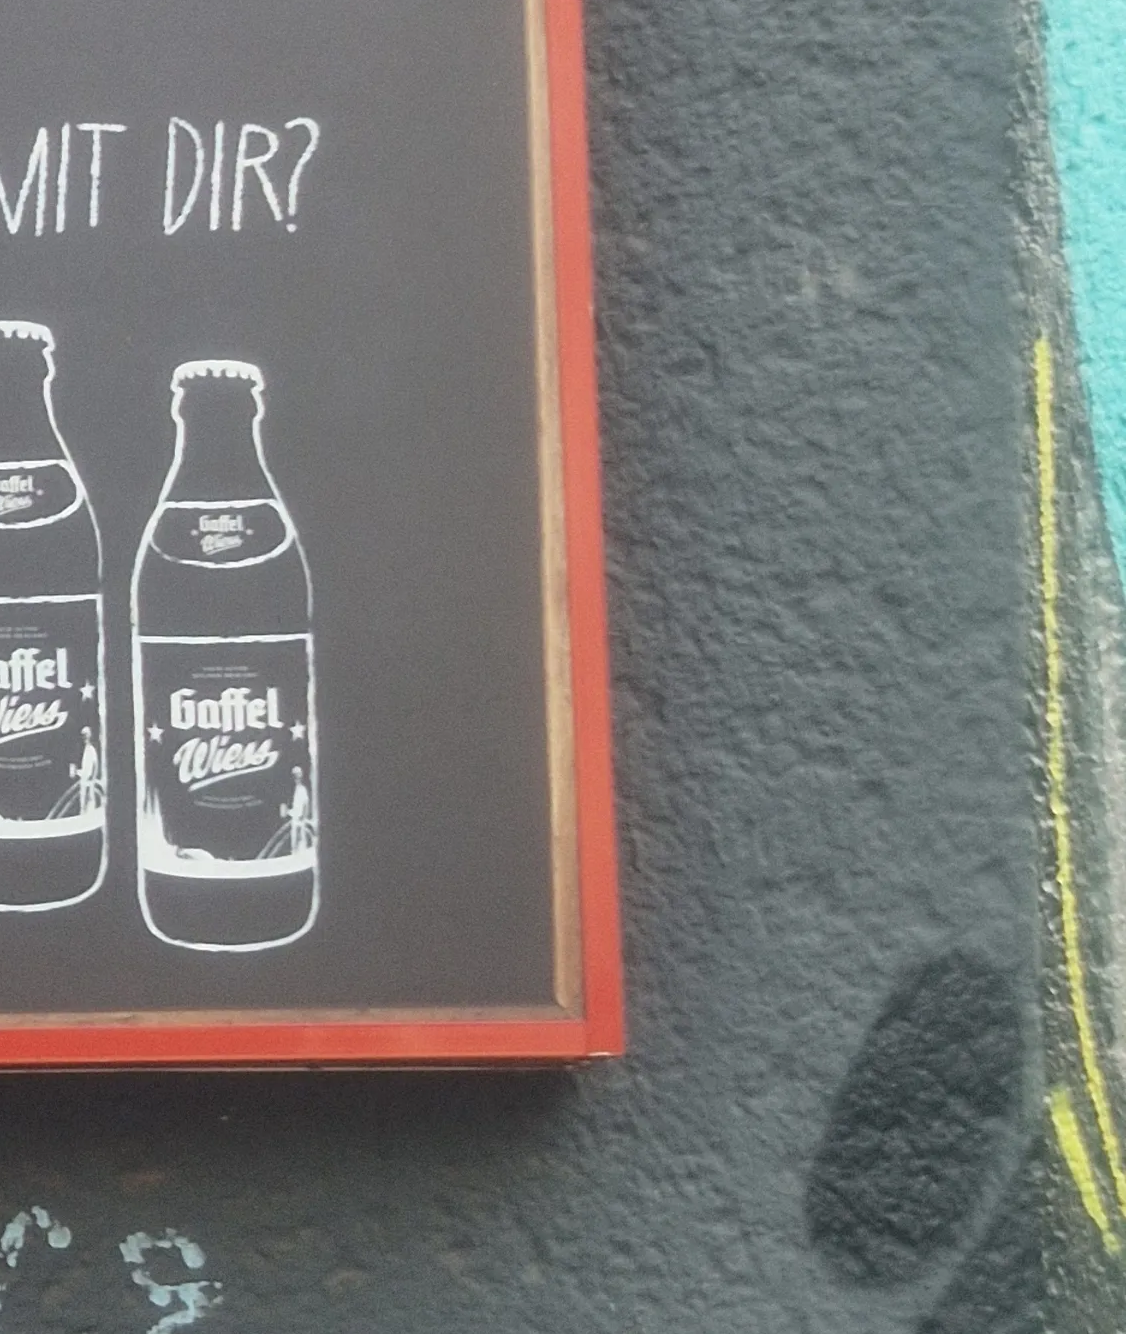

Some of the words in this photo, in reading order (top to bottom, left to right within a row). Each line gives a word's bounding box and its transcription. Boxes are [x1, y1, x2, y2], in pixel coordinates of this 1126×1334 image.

[163, 116, 321, 236] DIR?
[199, 514, 244, 533] Gaffel
[170, 687, 285, 733] Gaffel
[172, 734, 280, 792] Wiess
